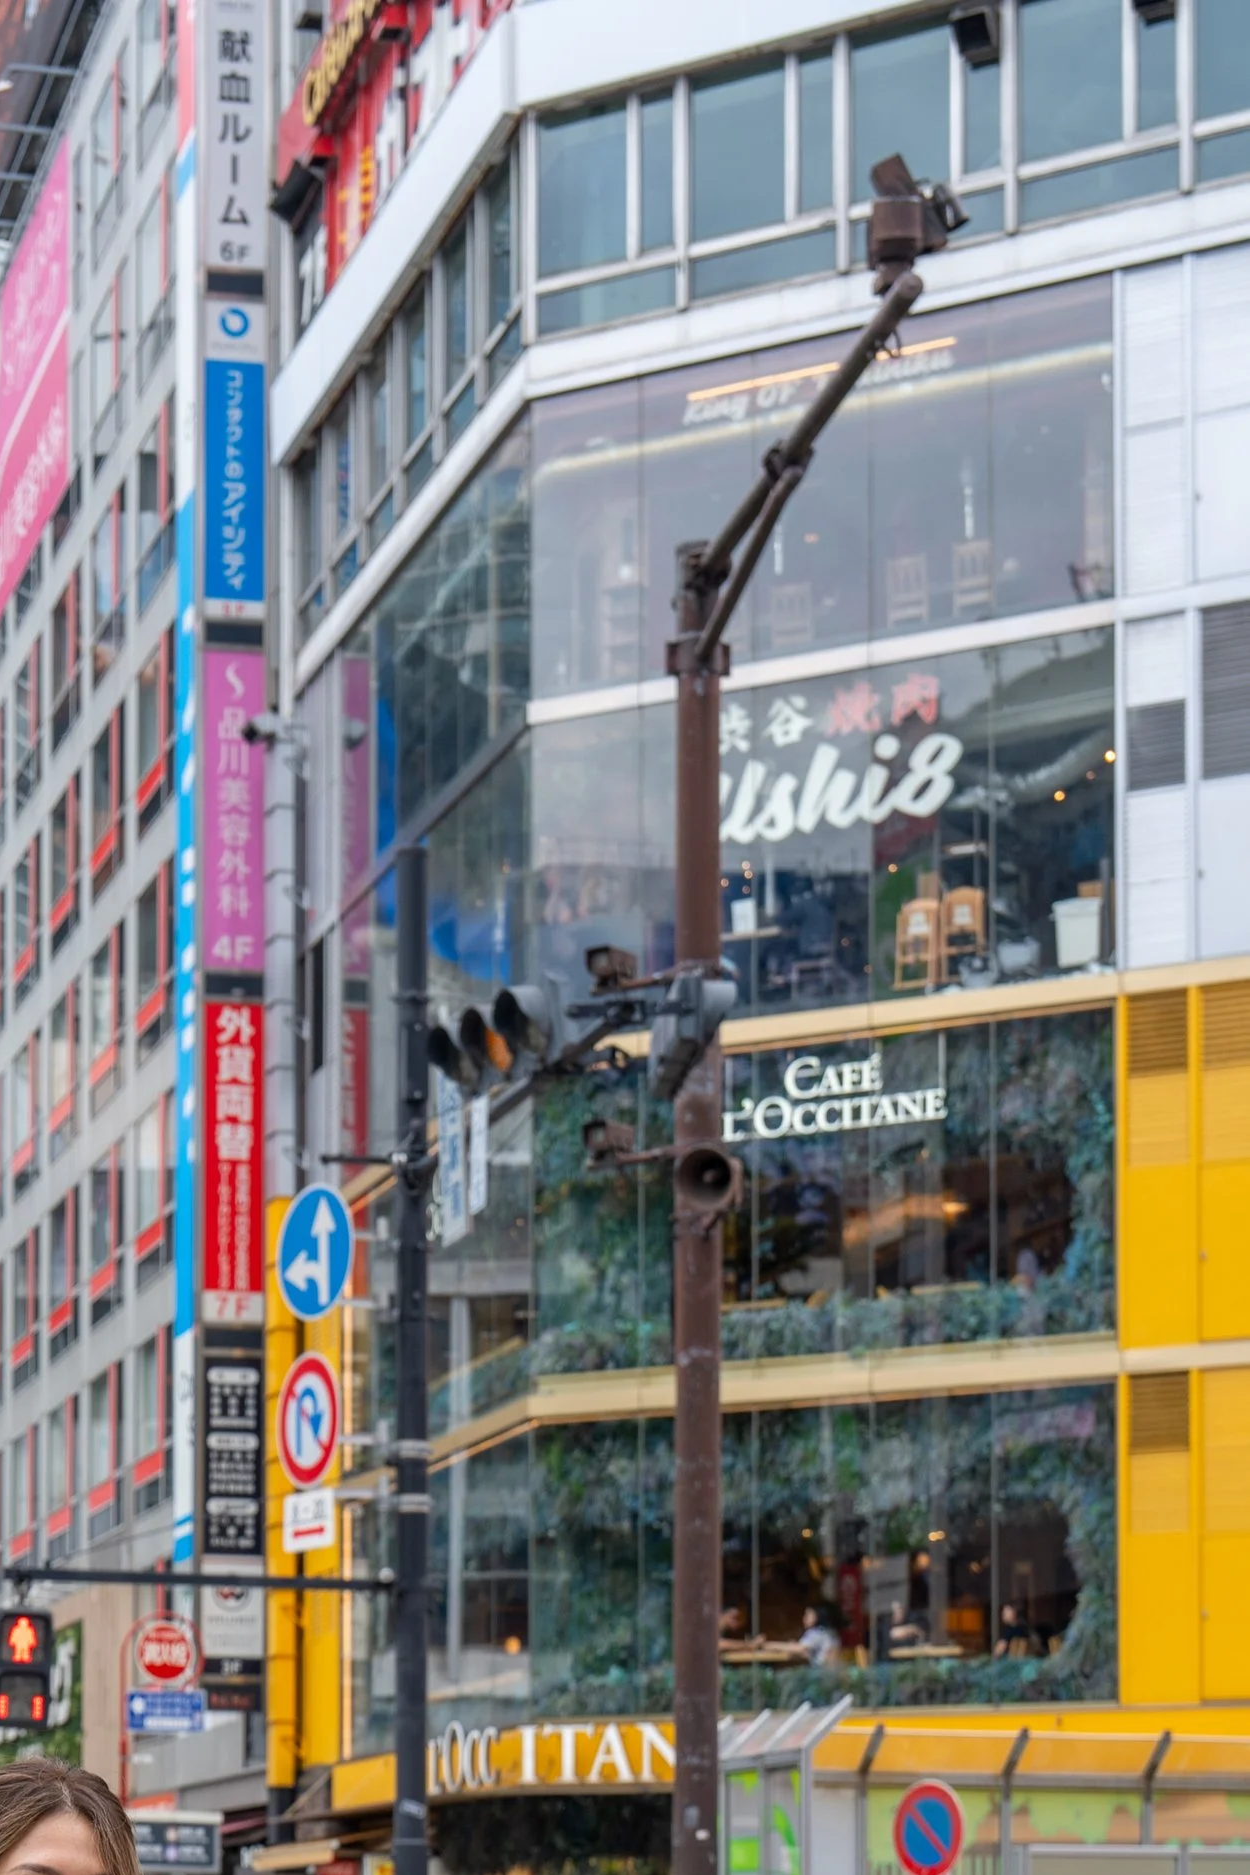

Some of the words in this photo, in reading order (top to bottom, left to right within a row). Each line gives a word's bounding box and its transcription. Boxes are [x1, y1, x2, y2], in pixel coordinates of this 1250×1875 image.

[218, 30, 253, 226] 献血ルーム
[220, 240, 251, 263] 6F
[217, 706, 252, 919] 品川美容外科
[212, 934, 255, 964] 4F
[215, 1006, 256, 1161] 外貨両替
[721, 1088, 949, 1143] L'OCCITANE
[215, 1292, 250, 1318] 7F
